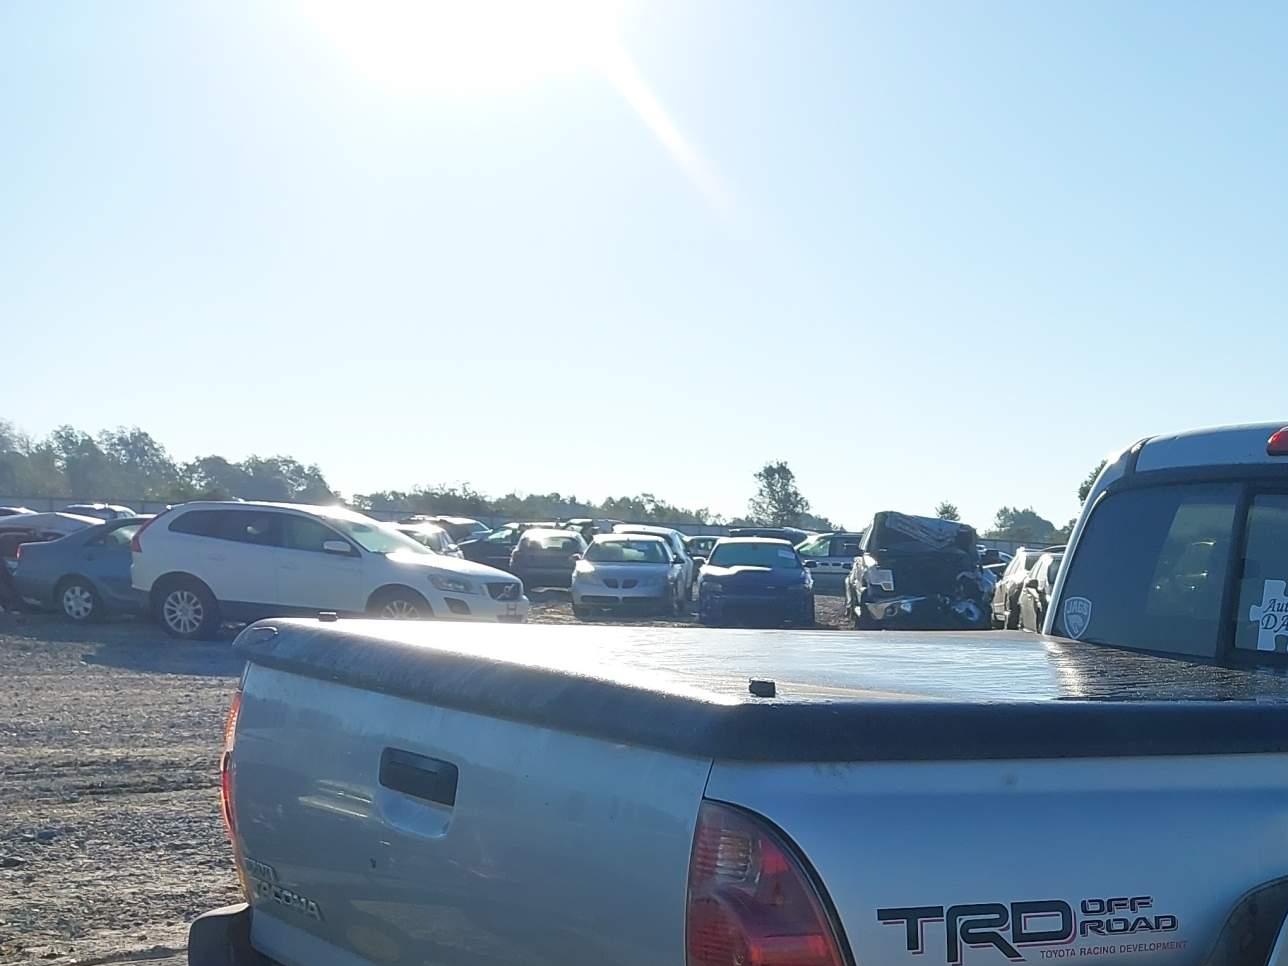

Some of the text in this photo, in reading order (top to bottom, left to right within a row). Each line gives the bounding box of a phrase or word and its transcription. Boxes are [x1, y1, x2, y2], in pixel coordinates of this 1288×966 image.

[1080, 896, 1154, 916] OFF
[876, 899, 1077, 966] TRD
[1079, 915, 1179, 938] ROAD
[1040, 940, 1188, 959] TOYOTA RACING DEVELOPMENT
